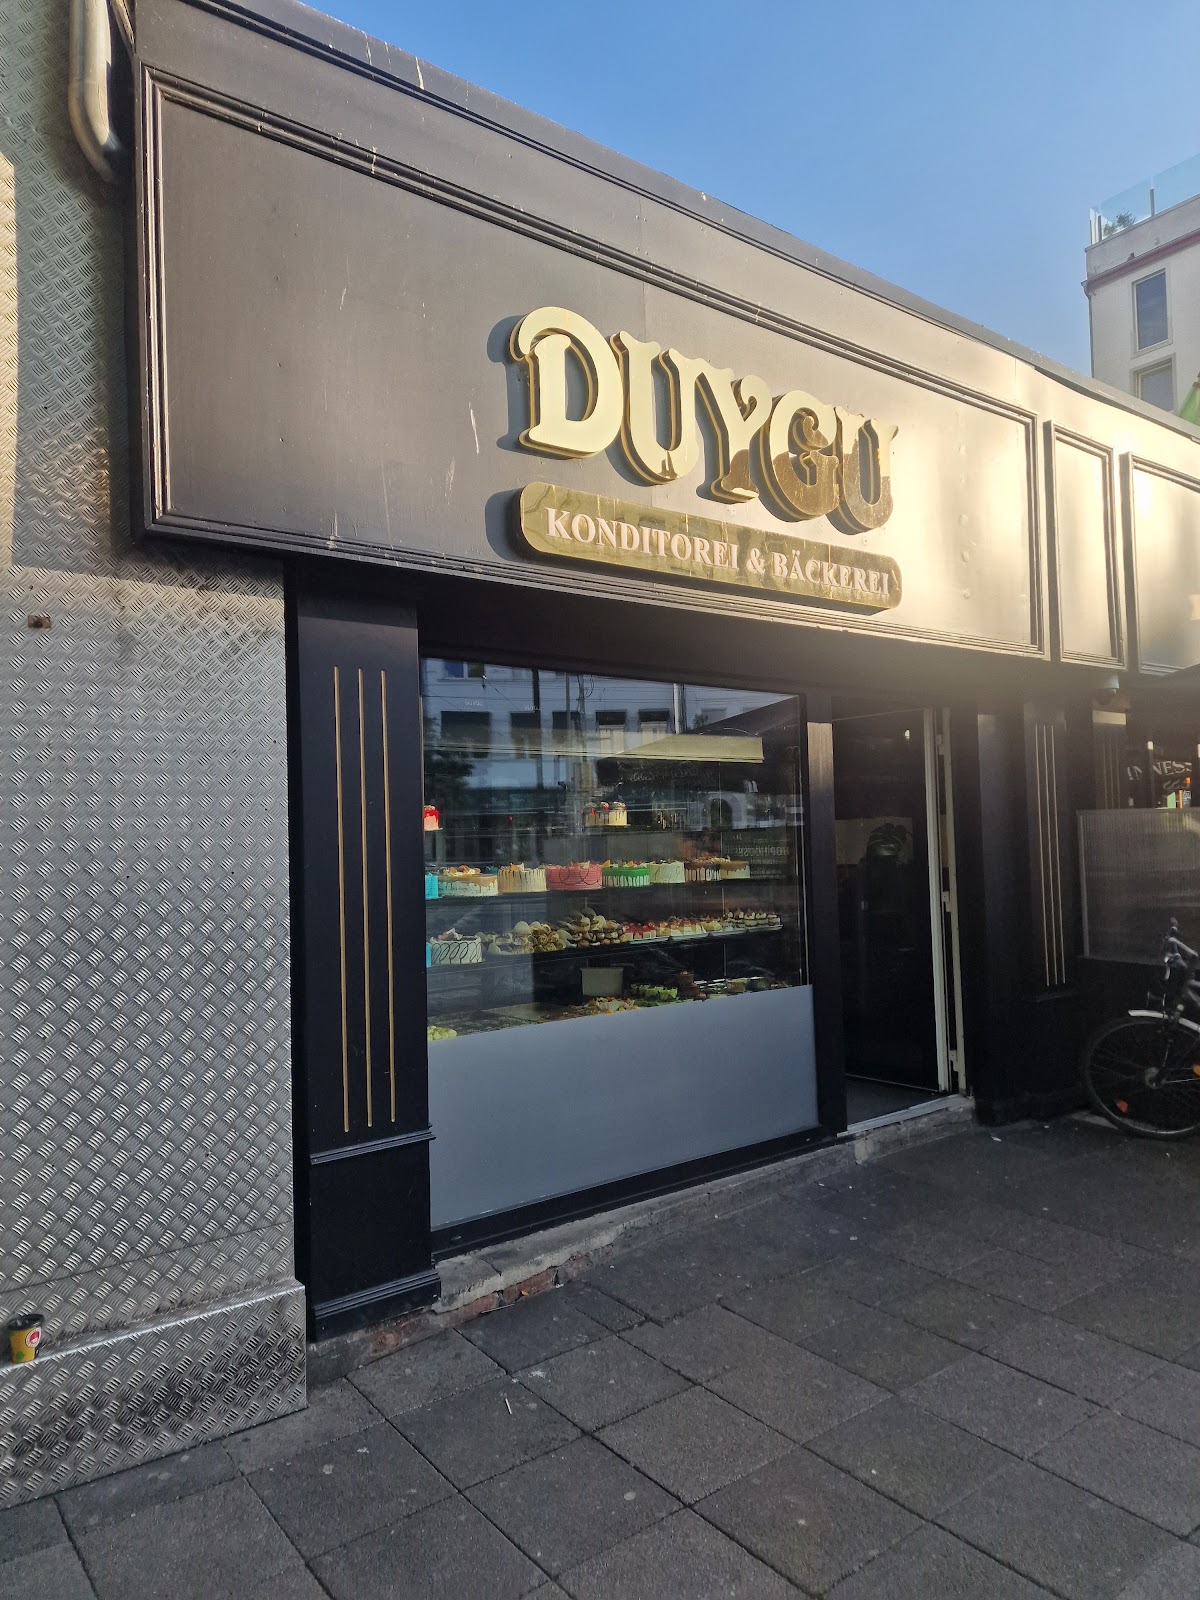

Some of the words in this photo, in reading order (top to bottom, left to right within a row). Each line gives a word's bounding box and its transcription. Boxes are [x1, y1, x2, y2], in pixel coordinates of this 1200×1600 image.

[509, 306, 898, 534] DUYGU
[545, 507, 739, 570] KONDITOREI
[746, 548, 766, 575] &
[772, 550, 891, 596] BÄCKEREI
